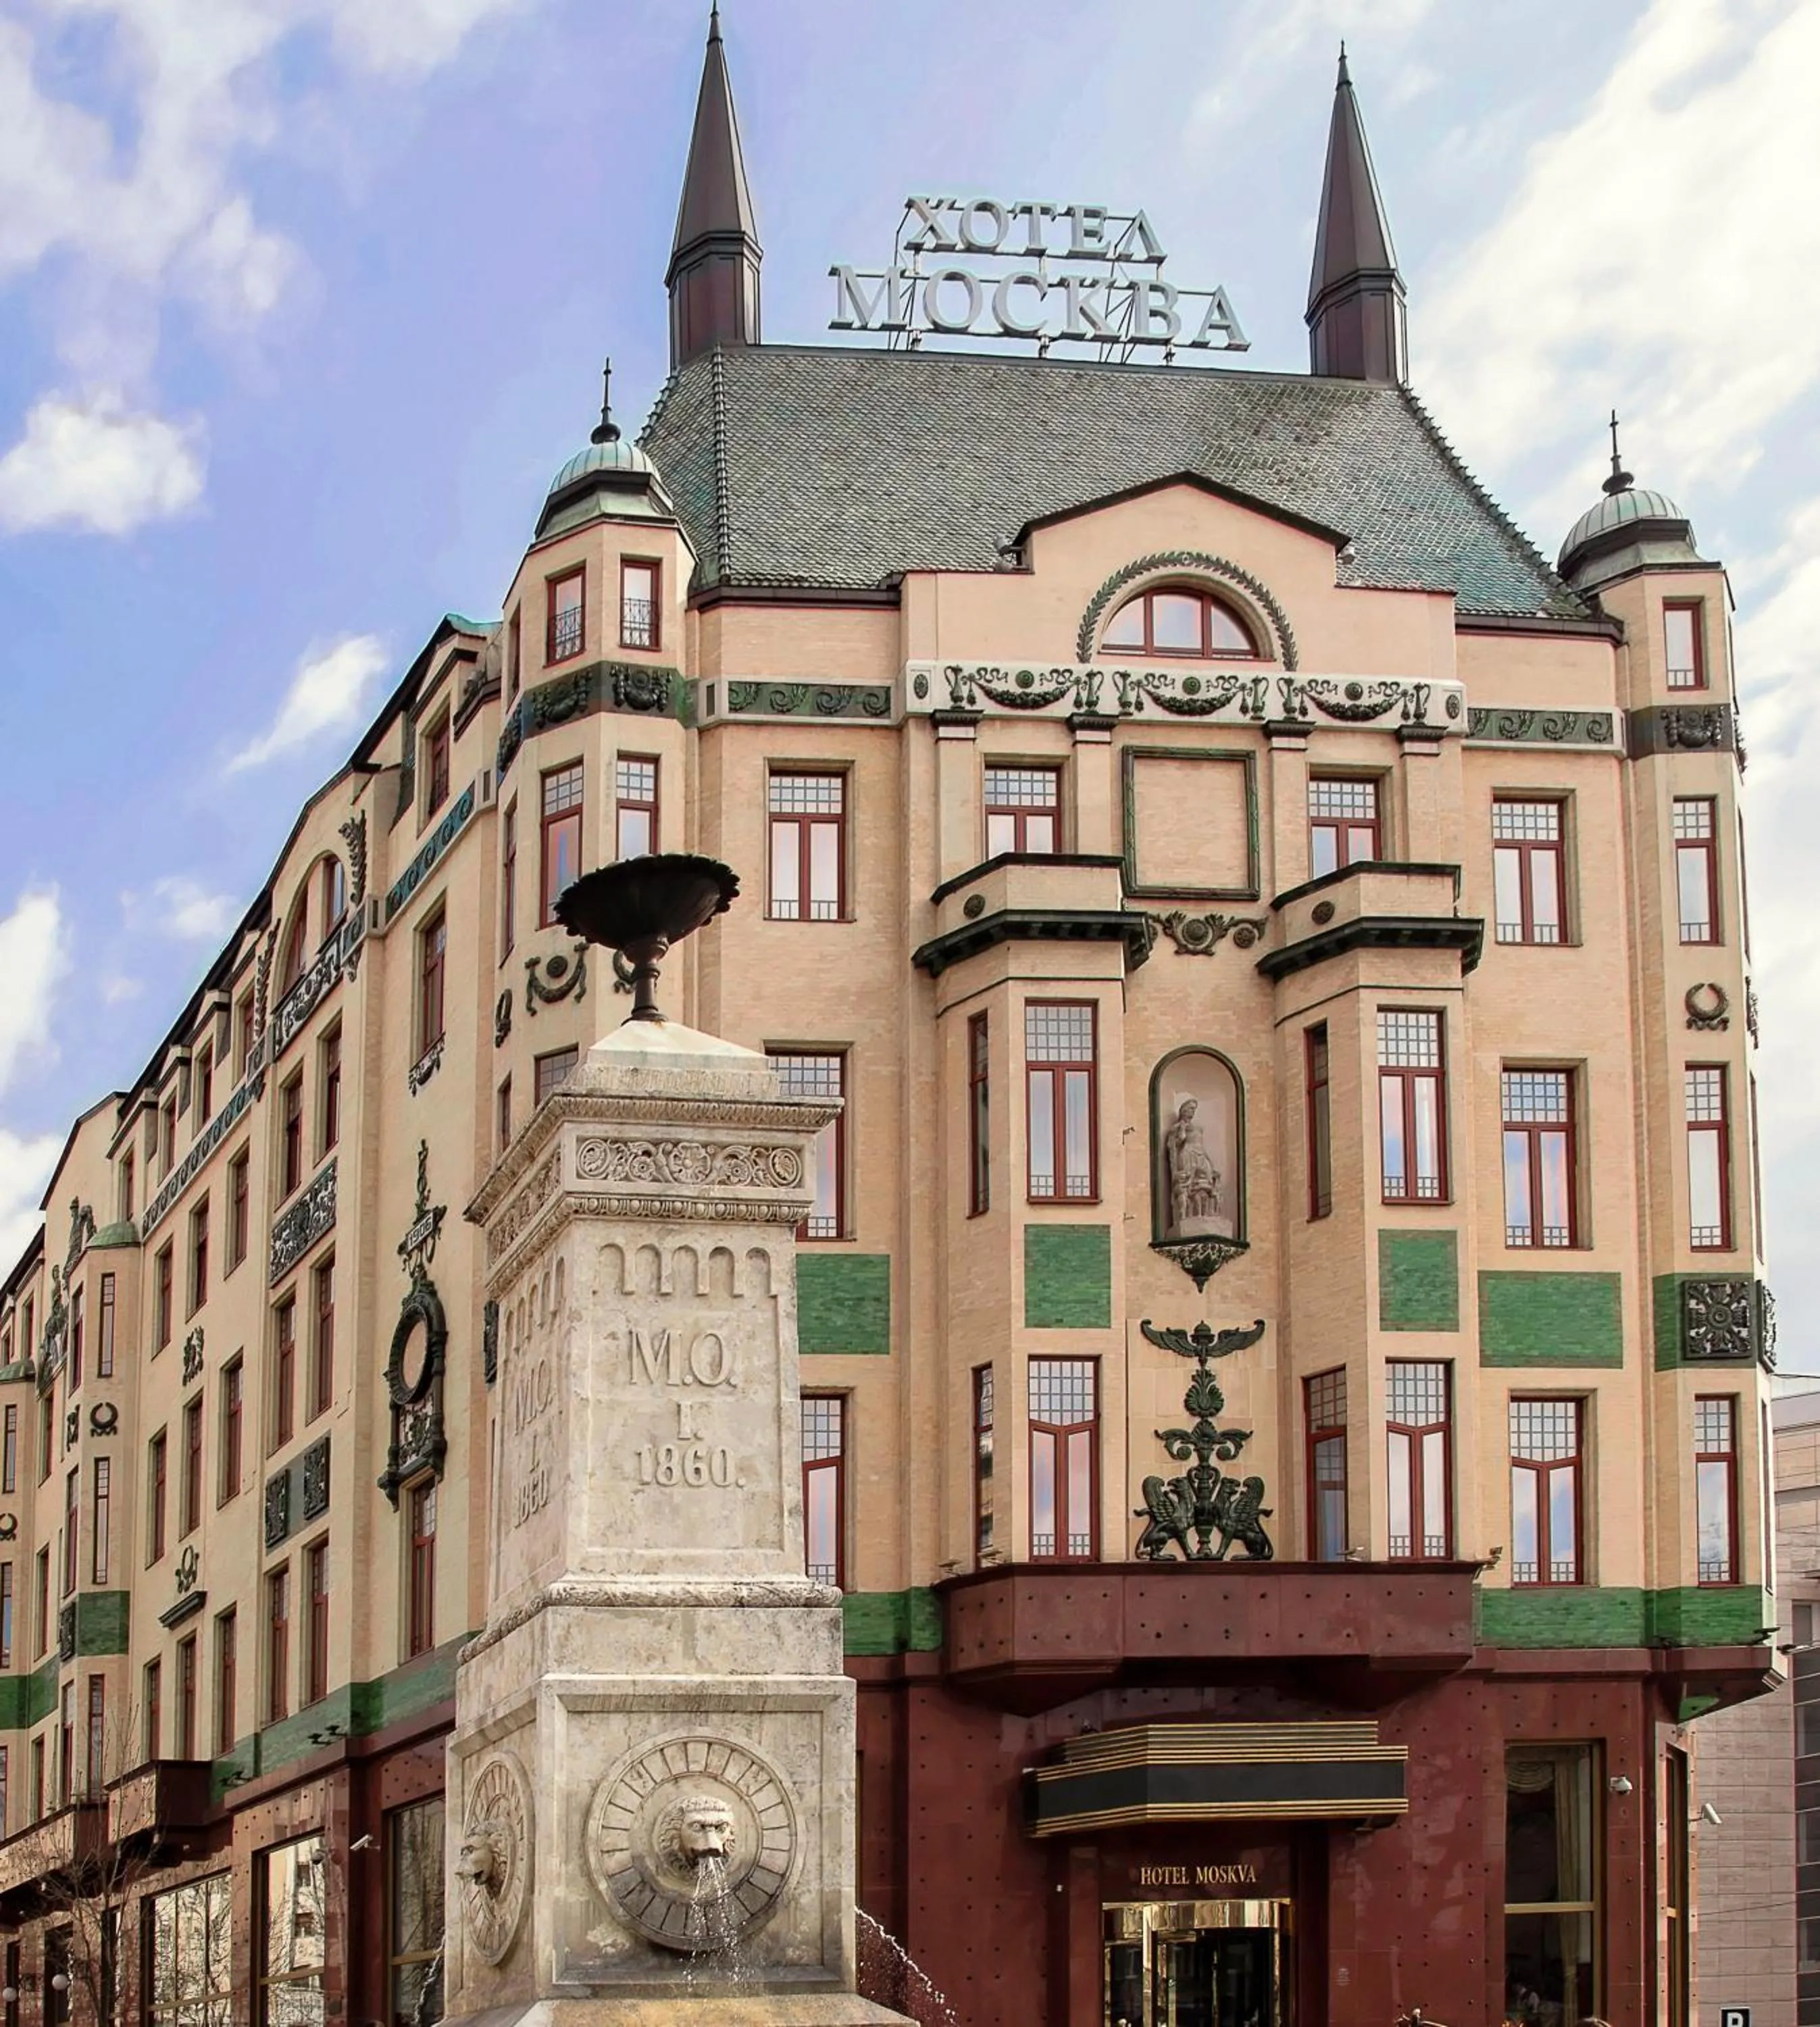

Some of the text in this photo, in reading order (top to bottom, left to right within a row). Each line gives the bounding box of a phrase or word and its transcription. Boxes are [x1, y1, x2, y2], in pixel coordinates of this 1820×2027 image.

[903, 196, 1167, 263] ХОТЕЛ
[828, 264, 1251, 352] МОСКВА
[409, 1216, 432, 1247] 1906
[1140, 1864, 1256, 1885] HOTEL MOSKVA
